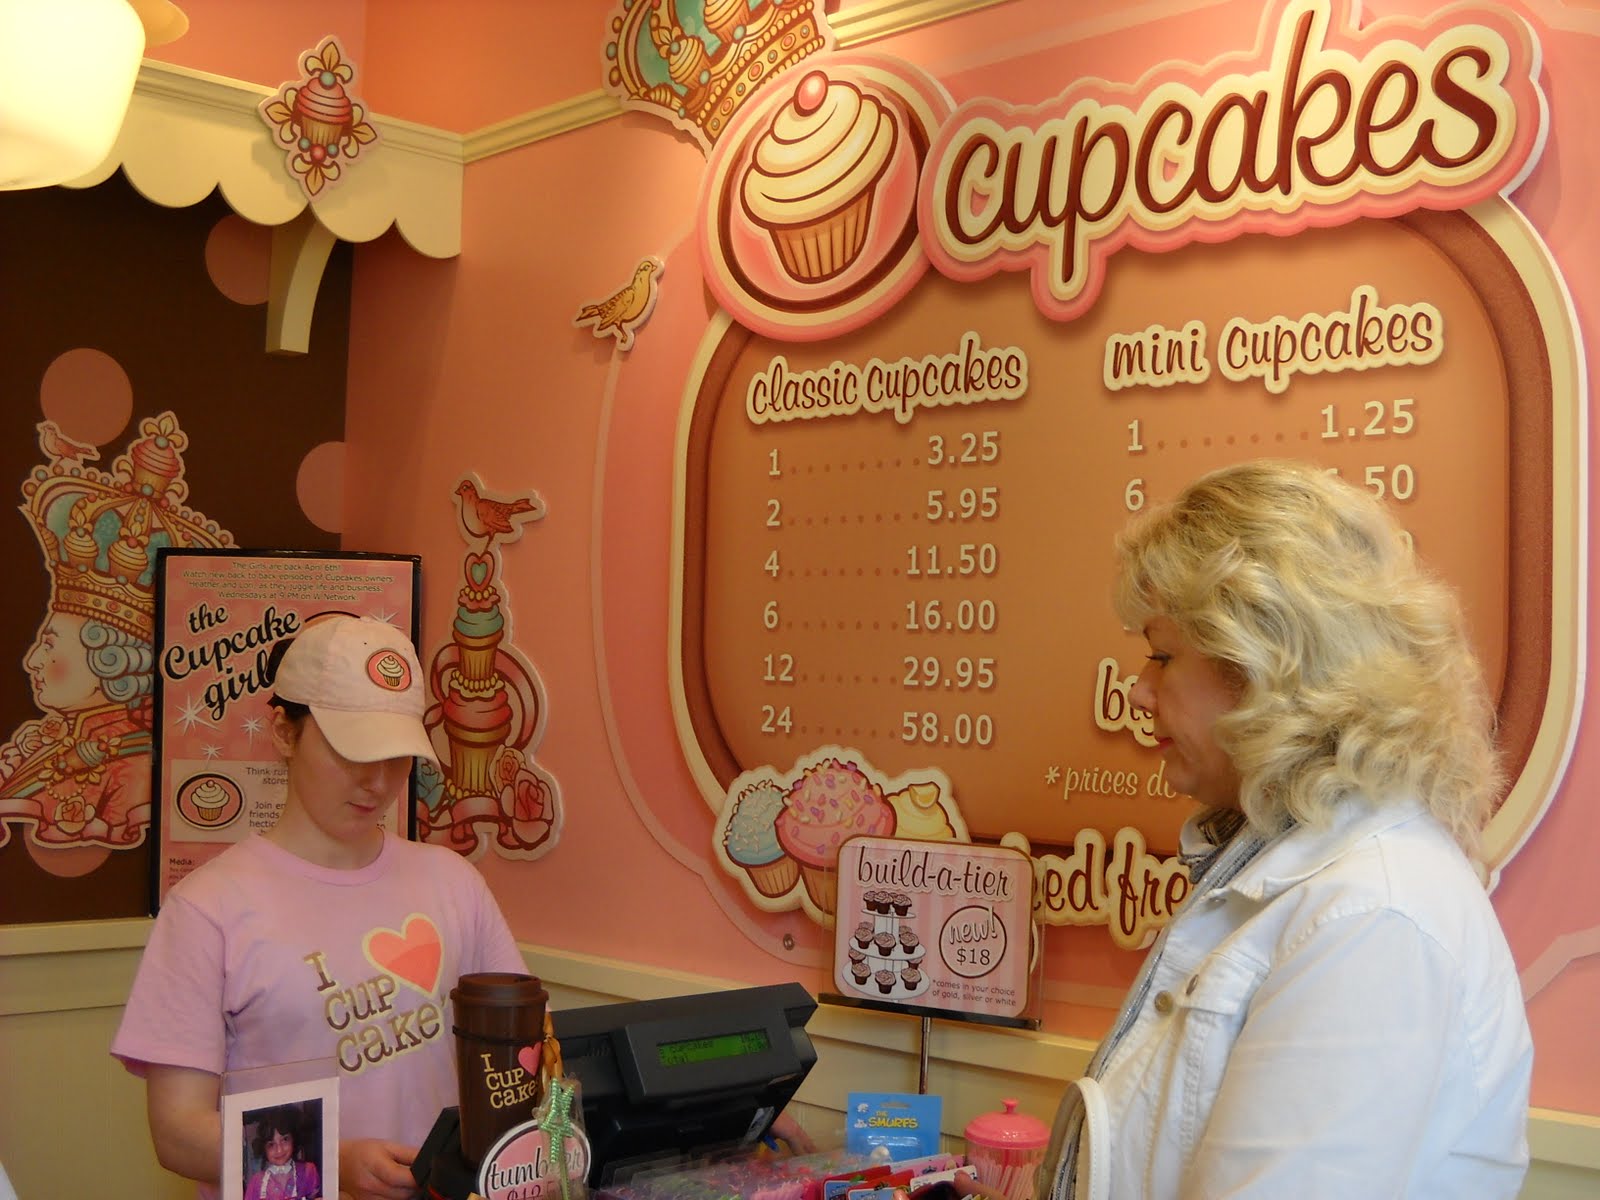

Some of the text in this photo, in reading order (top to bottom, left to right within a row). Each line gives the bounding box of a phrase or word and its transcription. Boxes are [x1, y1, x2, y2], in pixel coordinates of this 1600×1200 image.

[945, 9, 1499, 284] cupcakes
[1112, 328, 1204, 380] mini
[752, 362, 858, 415] classic
[1127, 398, 1415, 452] 1 1.25
[768, 430, 999, 476] 1 3.25
[766, 486, 998, 527] 2 5.95
[1124, 478, 1145, 512] 6
[764, 542, 998, 577] 4 11.50
[188, 603, 229, 634] the
[763, 598, 997, 631] 6 16.00
[164, 606, 301, 680] Cupcake
[204, 649, 275, 722] girl
[762, 653, 995, 689] 12 29.95
[760, 704, 994, 746] 24 58.00
[246, 767, 270, 776] Think
[249, 810, 280, 819] friends
[255, 801, 273, 810] Join
[857, 845, 1009, 898] build-a-tier
[949, 905, 998, 945] new!
[303, 951, 337, 992] I
[956, 945, 991, 967] $18
[971, 984, 989, 993] your
[990, 986, 1016, 997] choice
[995, 997, 1017, 1007] white
[480, 1053, 495, 1074] I
[868, 1117, 919, 1129] SMURFS
